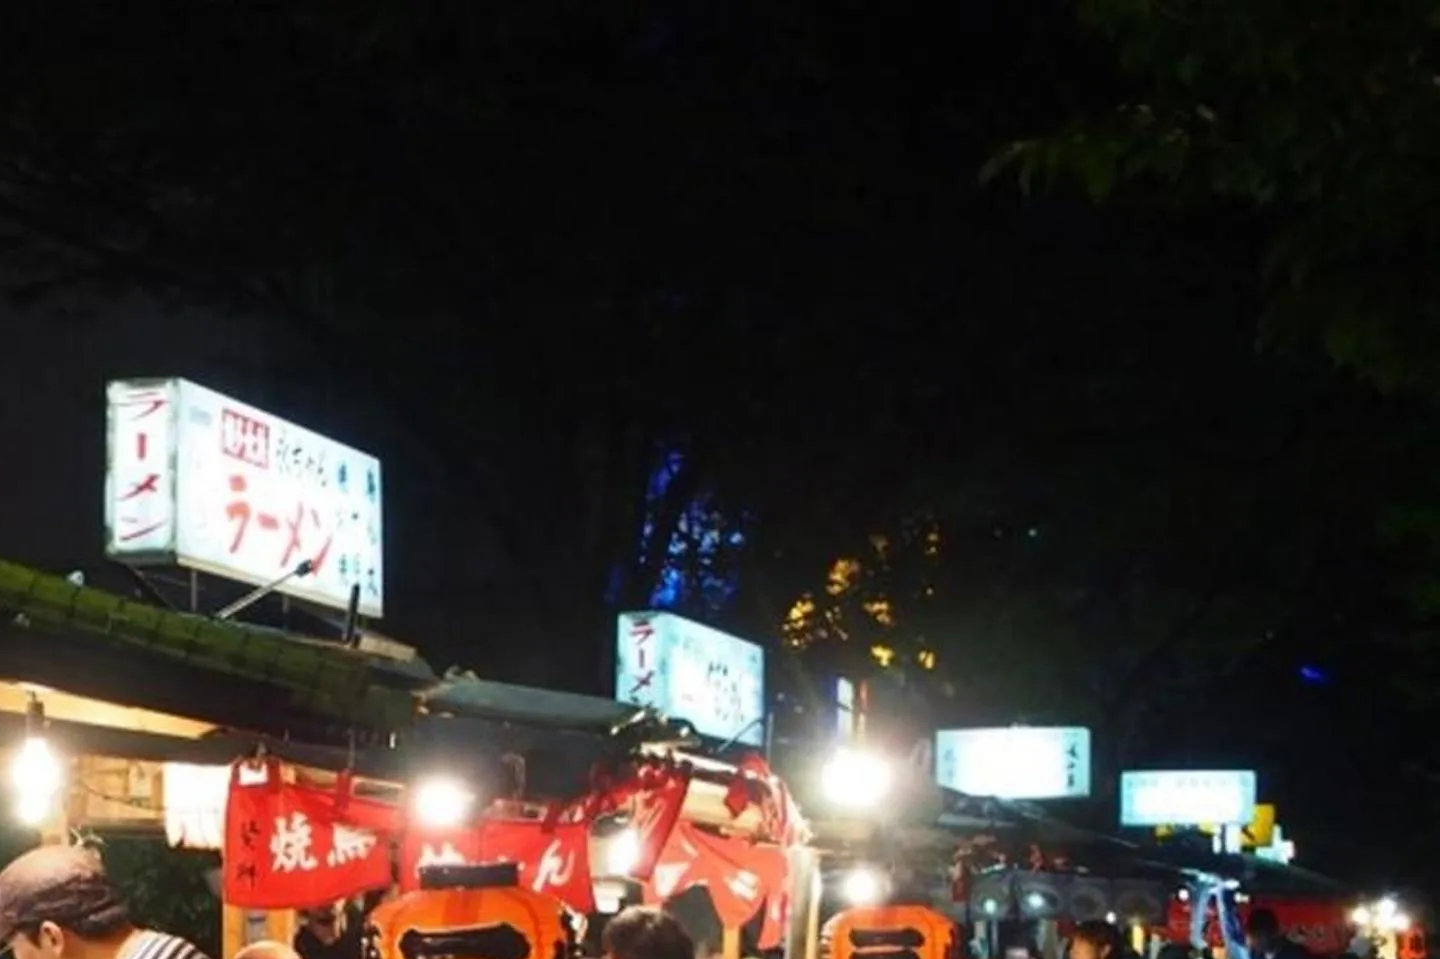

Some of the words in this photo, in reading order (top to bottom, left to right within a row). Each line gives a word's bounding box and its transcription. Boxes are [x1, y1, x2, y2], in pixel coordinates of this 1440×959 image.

[114, 391, 167, 541] ラーメン
[225, 474, 333, 576] ラーメン
